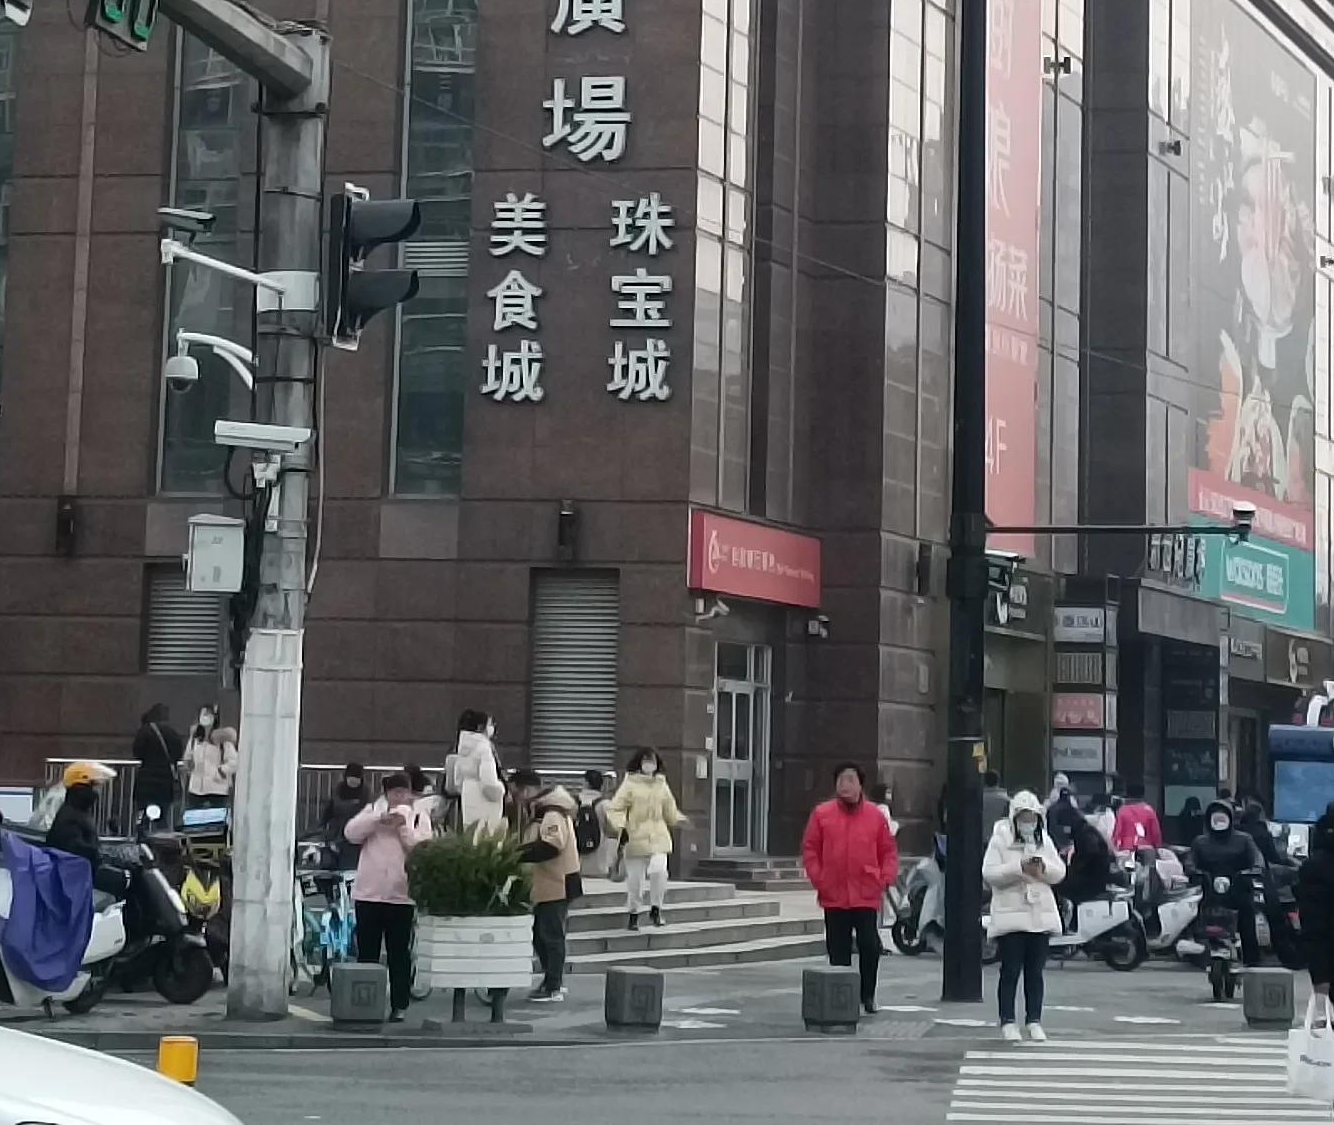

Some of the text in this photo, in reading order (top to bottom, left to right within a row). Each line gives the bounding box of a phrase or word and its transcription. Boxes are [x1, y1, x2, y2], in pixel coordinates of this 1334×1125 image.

[480, 192, 548, 402] 美食城
[607, 191, 675, 402] 珠宝城
